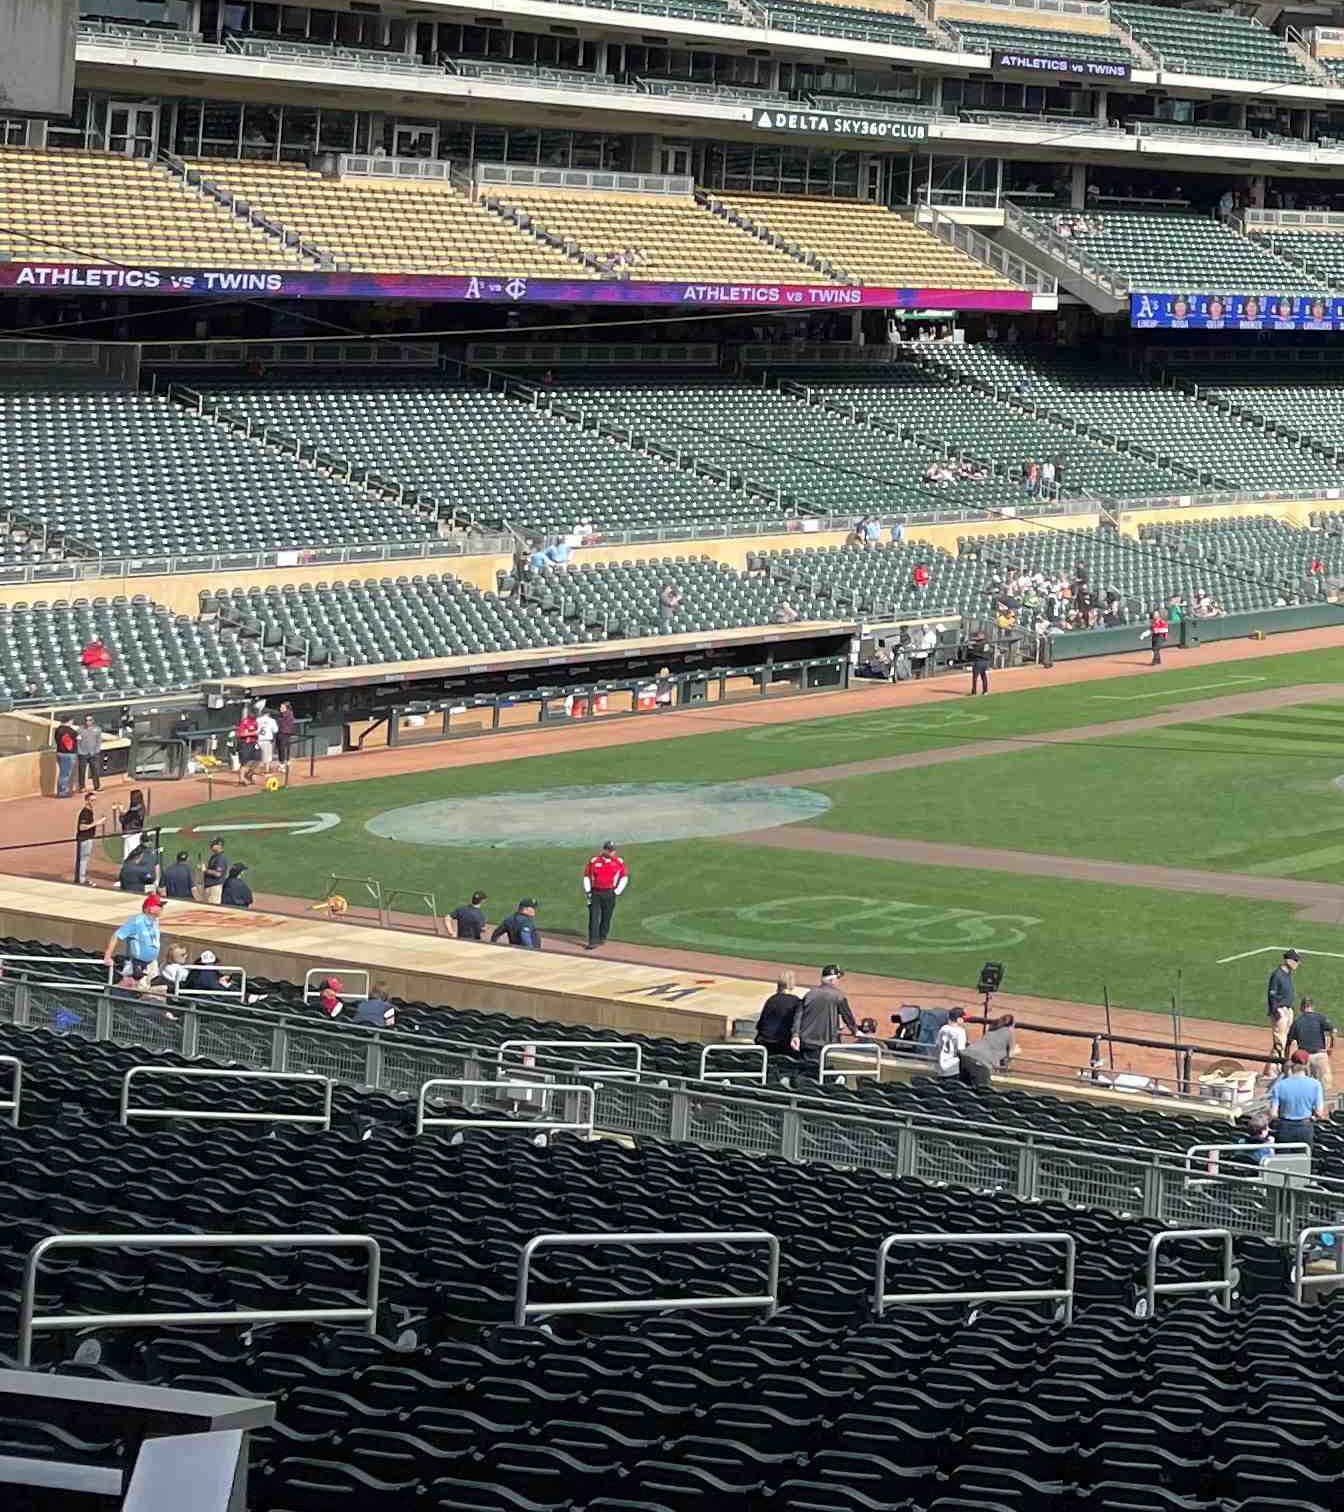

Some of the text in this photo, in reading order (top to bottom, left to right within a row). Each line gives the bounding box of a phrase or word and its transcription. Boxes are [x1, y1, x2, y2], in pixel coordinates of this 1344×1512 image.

[1001, 55, 1126, 76] ATHLETICS vs TWINS
[775, 113, 829, 132] DELTA
[15, 267, 282, 290] ATHLETICS vs TWINS
[683, 285, 862, 303] ATHLETICS vs TWINS
